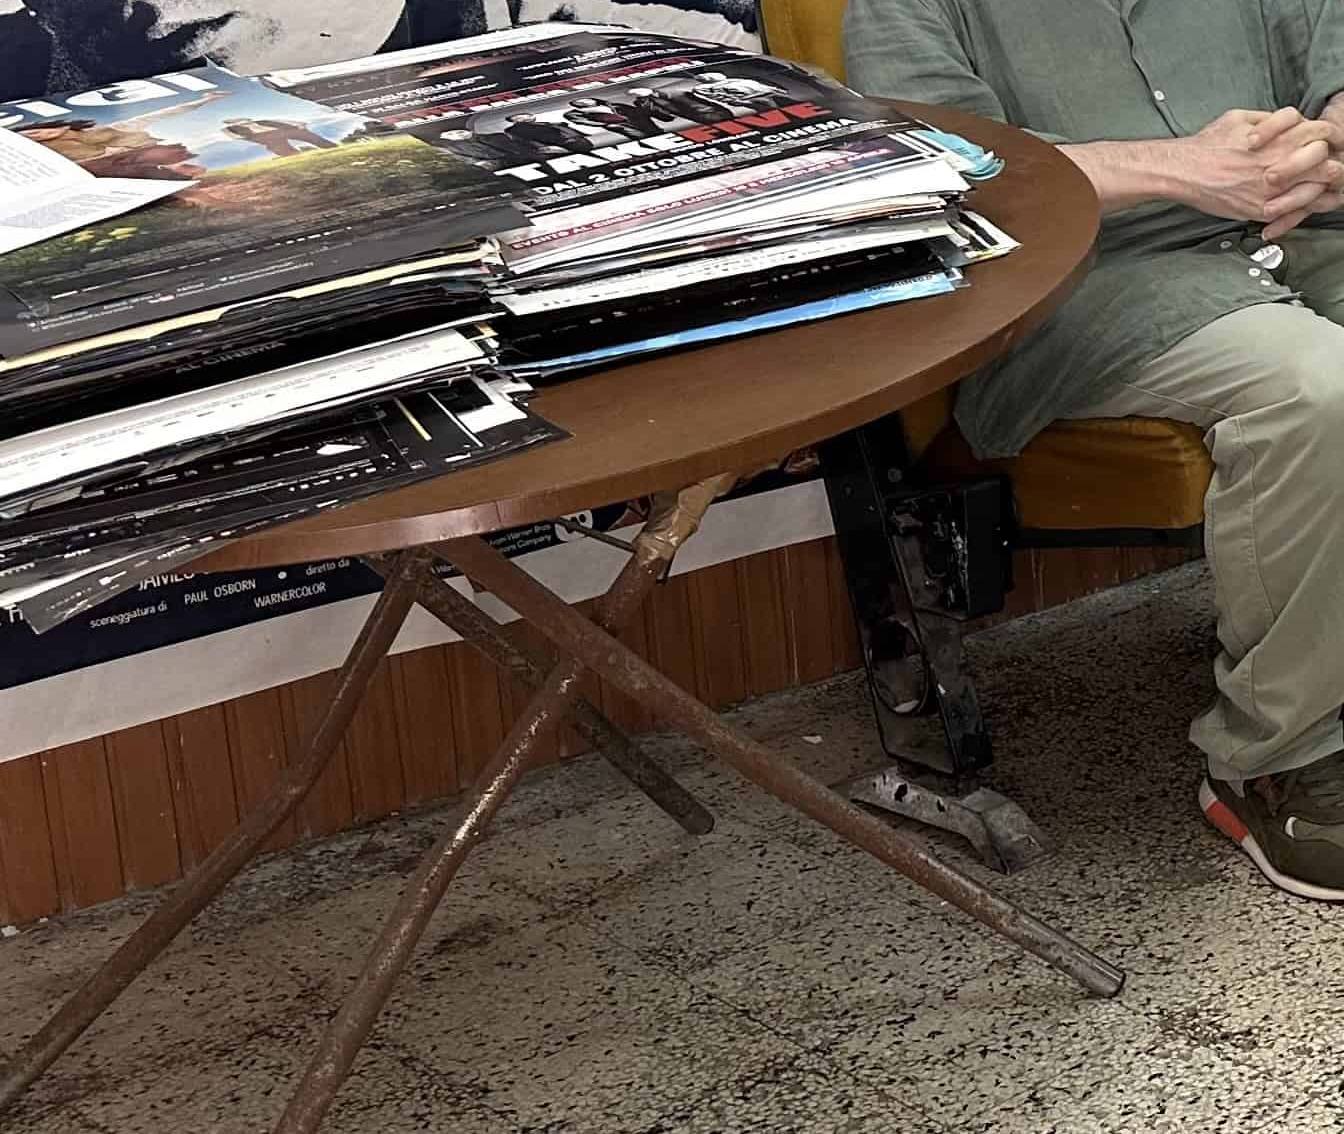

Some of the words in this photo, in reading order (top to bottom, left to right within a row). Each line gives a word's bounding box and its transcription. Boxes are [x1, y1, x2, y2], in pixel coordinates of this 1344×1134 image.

[495, 130, 686, 182] TAKE
[678, 101, 832, 144] FIVE
[532, 179, 587, 197] DAL
[587, 173, 608, 186] 2
[613, 145, 726, 178] OTTOBRE
[729, 137, 763, 154] AL
[767, 116, 861, 144] CINEMA
[305, 562, 336, 576] diretto
[90, 606, 157, 629] sceneggiatura
[158, 600, 168, 614] di
[184, 589, 209, 605] PAUL
[213, 578, 257, 599] OSBORN
[253, 582, 328, 608] WARNERCOLOR
